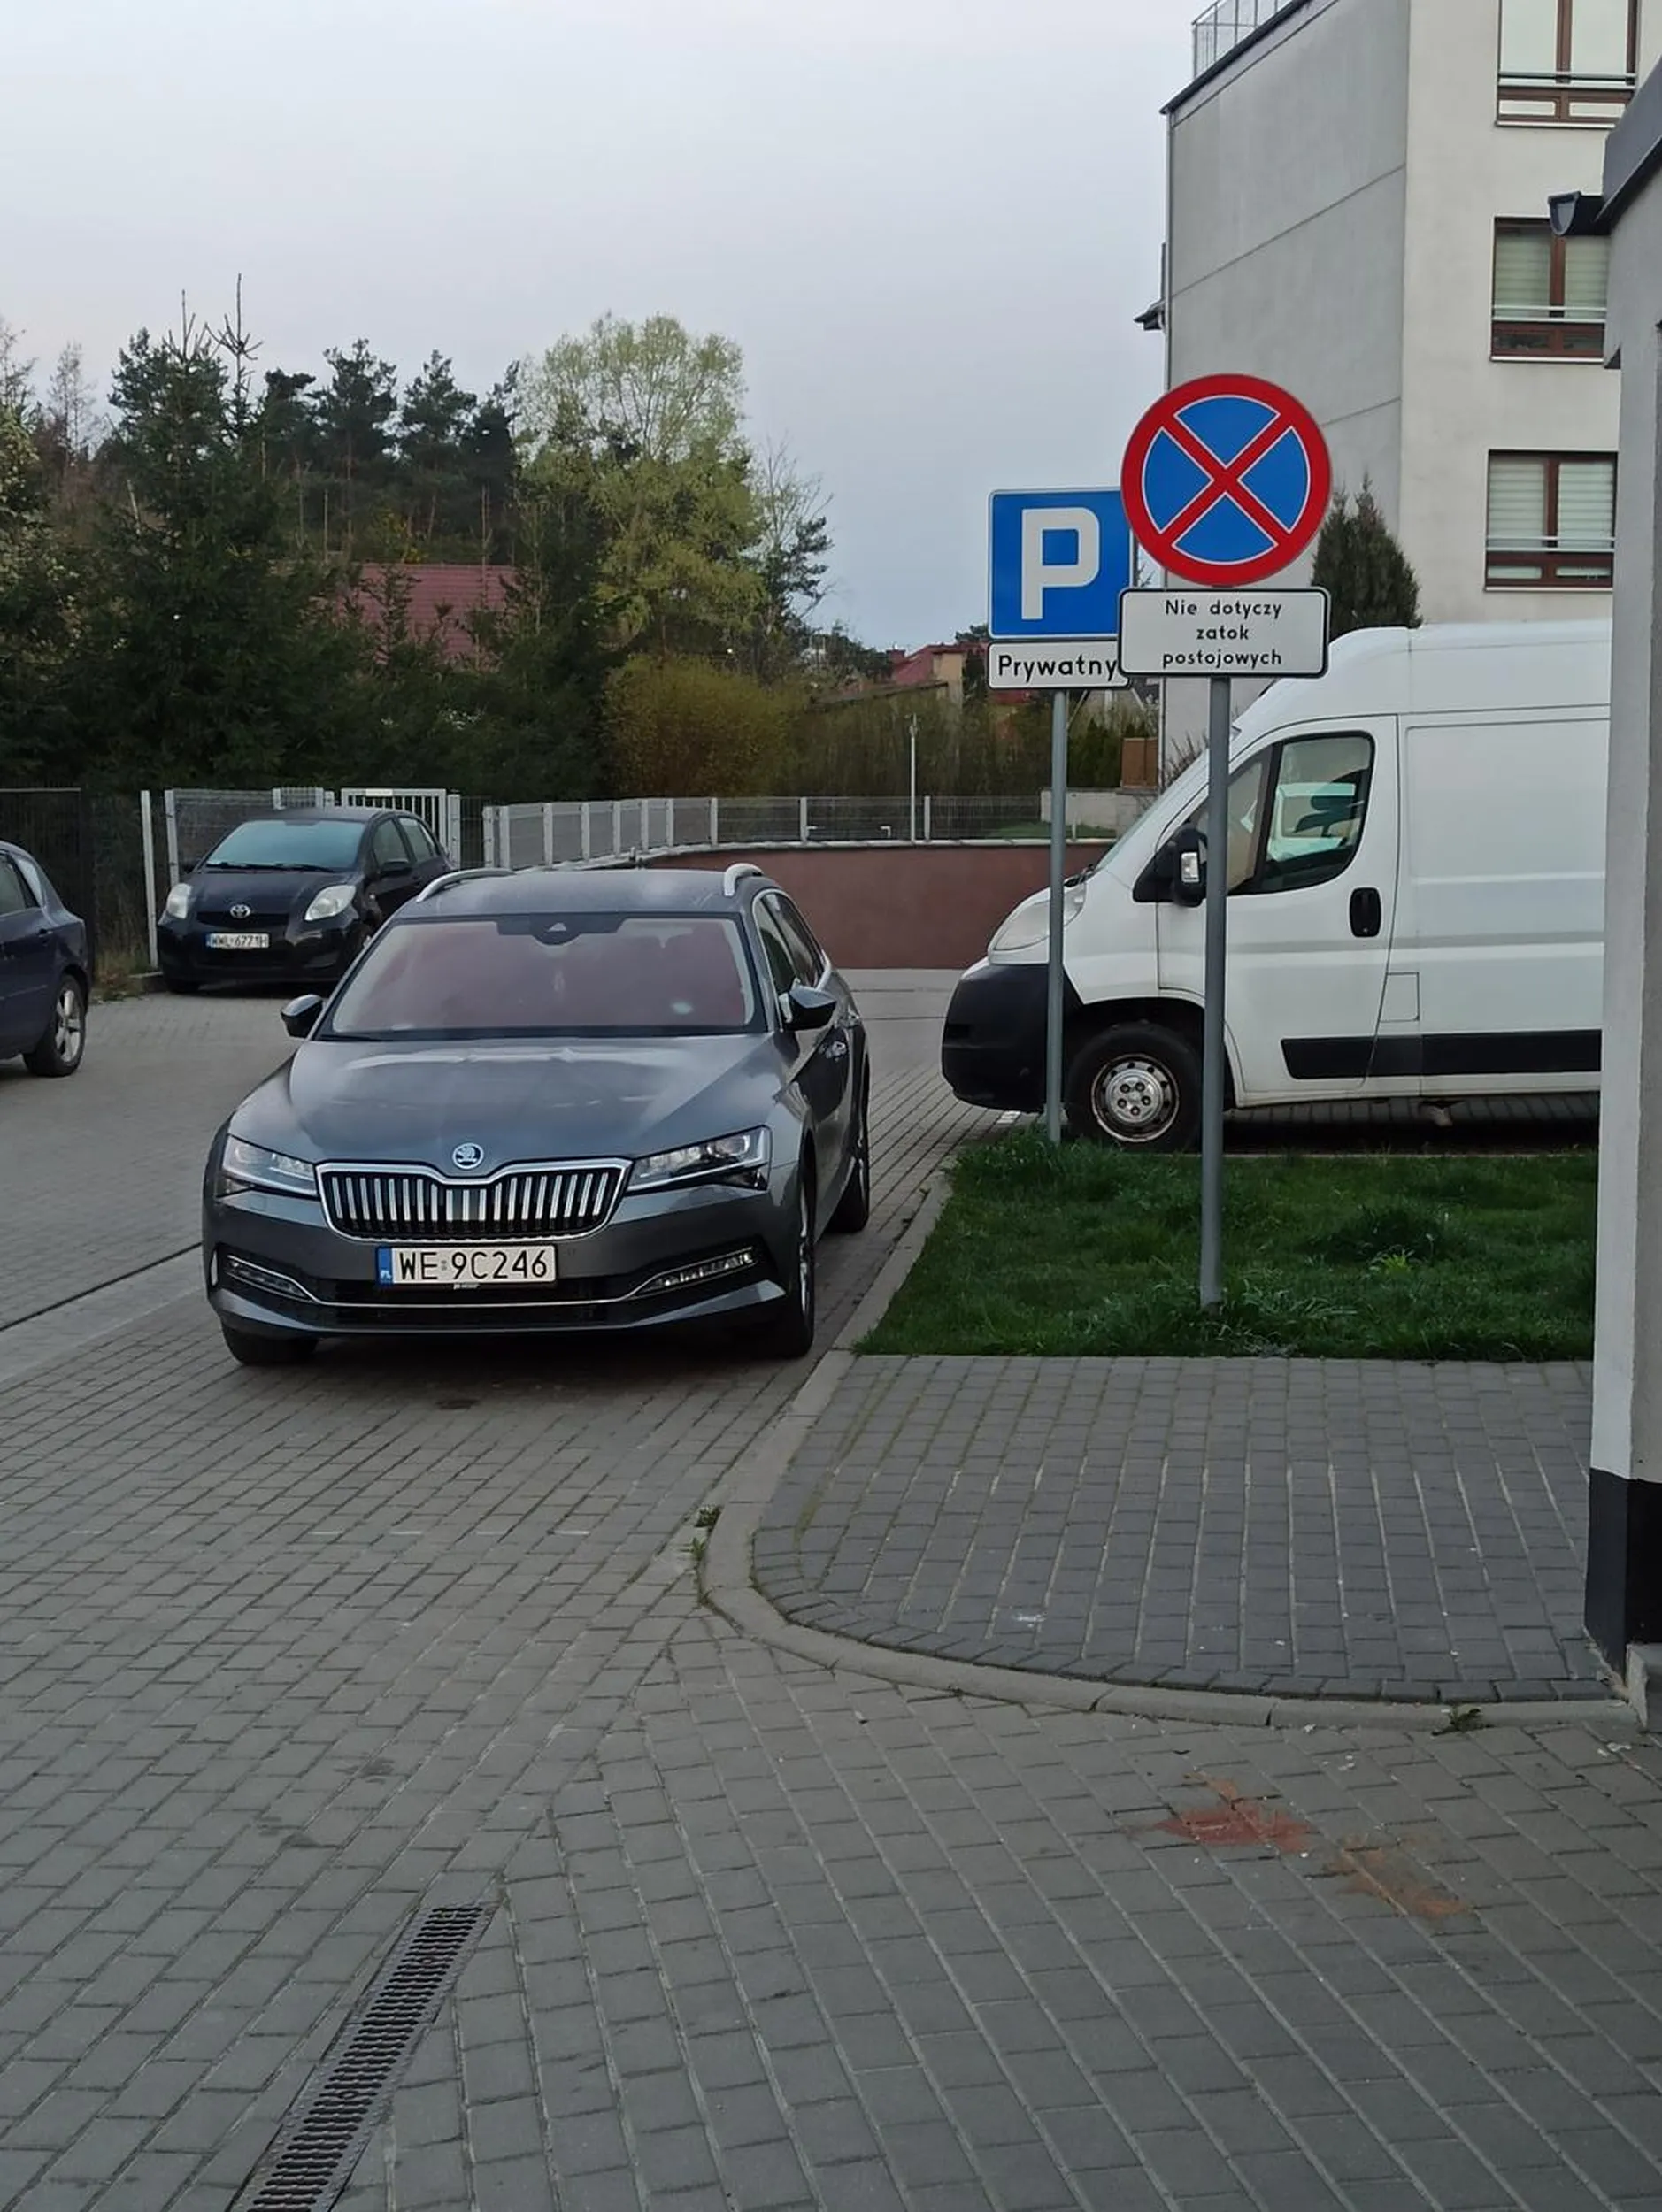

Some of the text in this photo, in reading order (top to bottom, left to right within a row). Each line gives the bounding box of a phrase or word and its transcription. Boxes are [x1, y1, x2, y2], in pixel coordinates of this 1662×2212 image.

[1020, 506, 1100, 620] P
[1165, 599, 1281, 619] Nie dotyczy
[1196, 624, 1250, 640] zatok
[998, 654, 1117, 683] Prywatny
[1163, 649, 1281, 670] postojowych
[399, 1250, 548, 1280] WE 9C246
